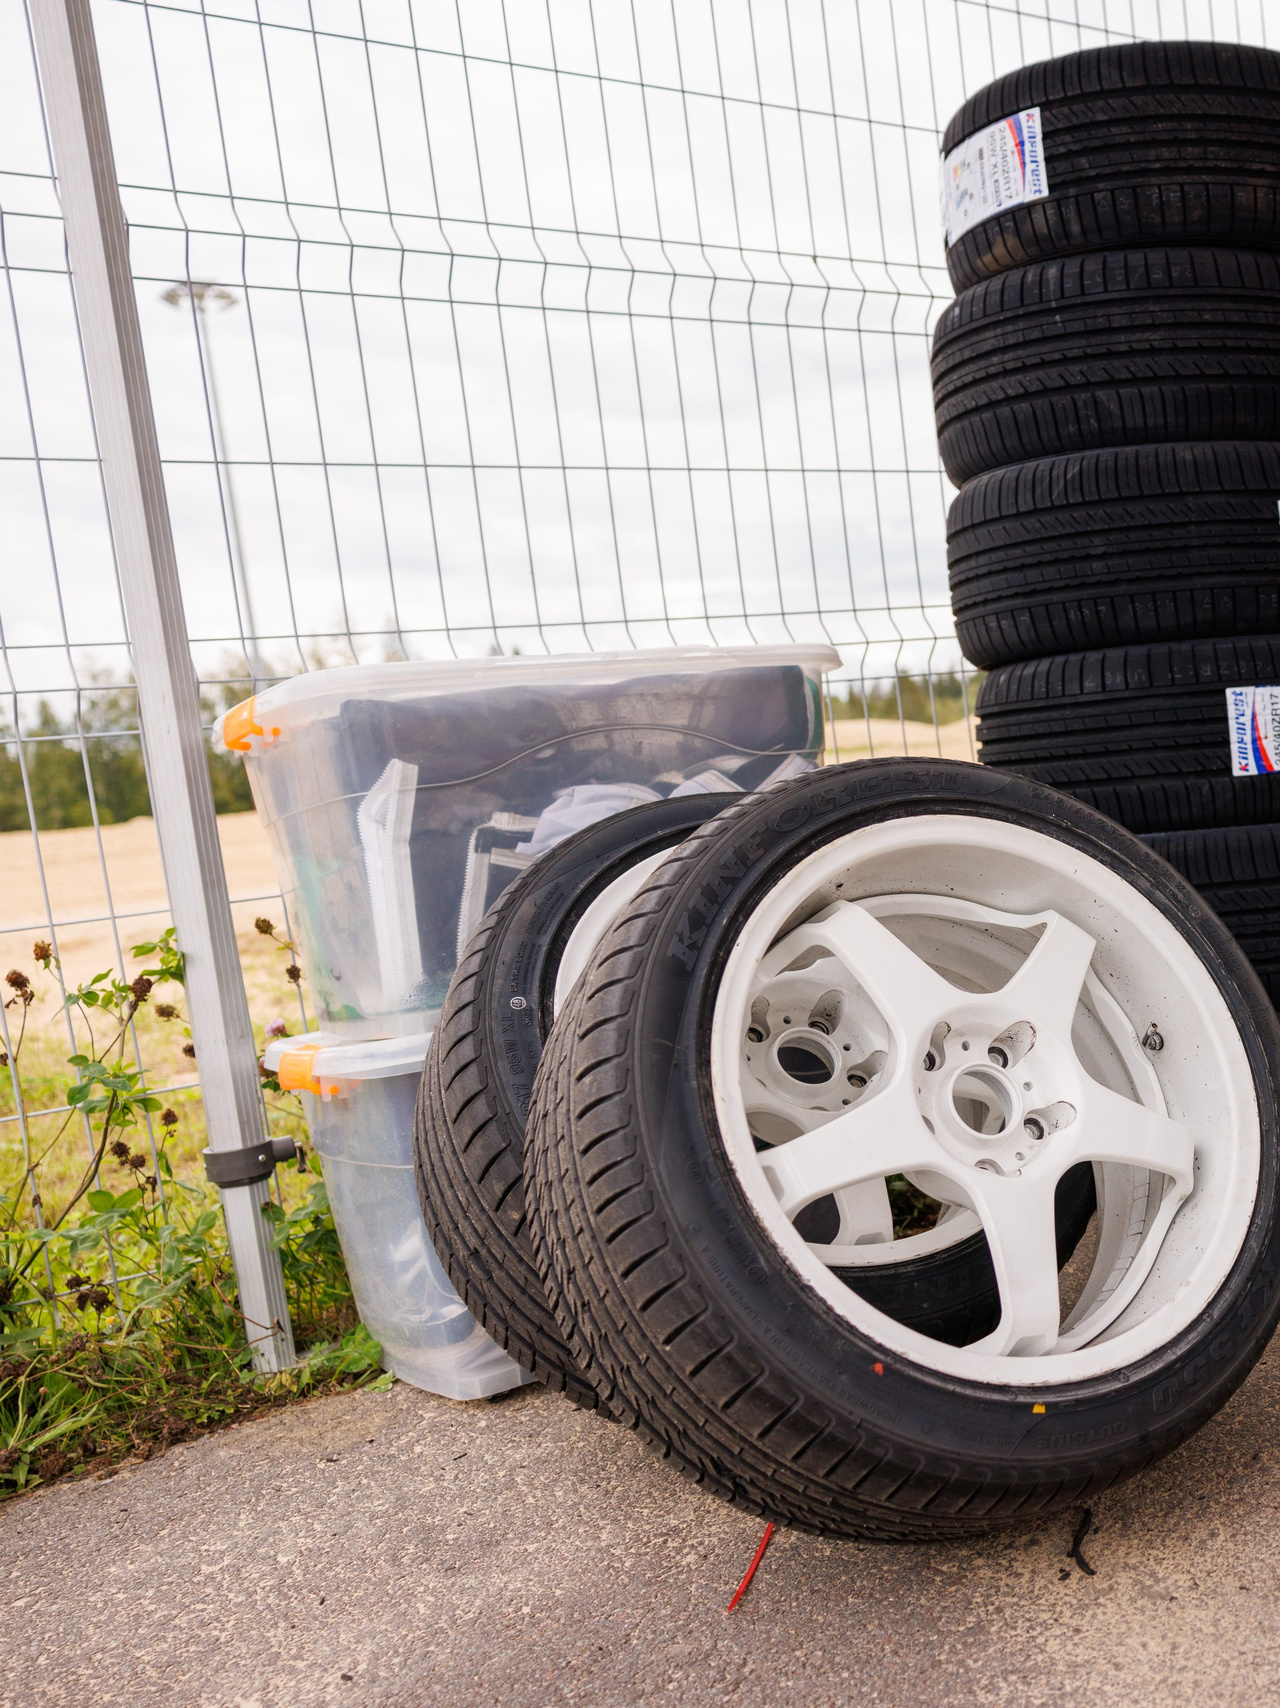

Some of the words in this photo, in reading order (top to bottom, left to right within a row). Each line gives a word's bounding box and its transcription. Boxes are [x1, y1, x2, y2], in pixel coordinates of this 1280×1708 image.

[667, 770, 970, 973] KINFOREST
[501, 1011, 516, 1034] XL
[503, 1038, 525, 1076] 95W
[1036, 1420, 1128, 1448] OUTSIDE
